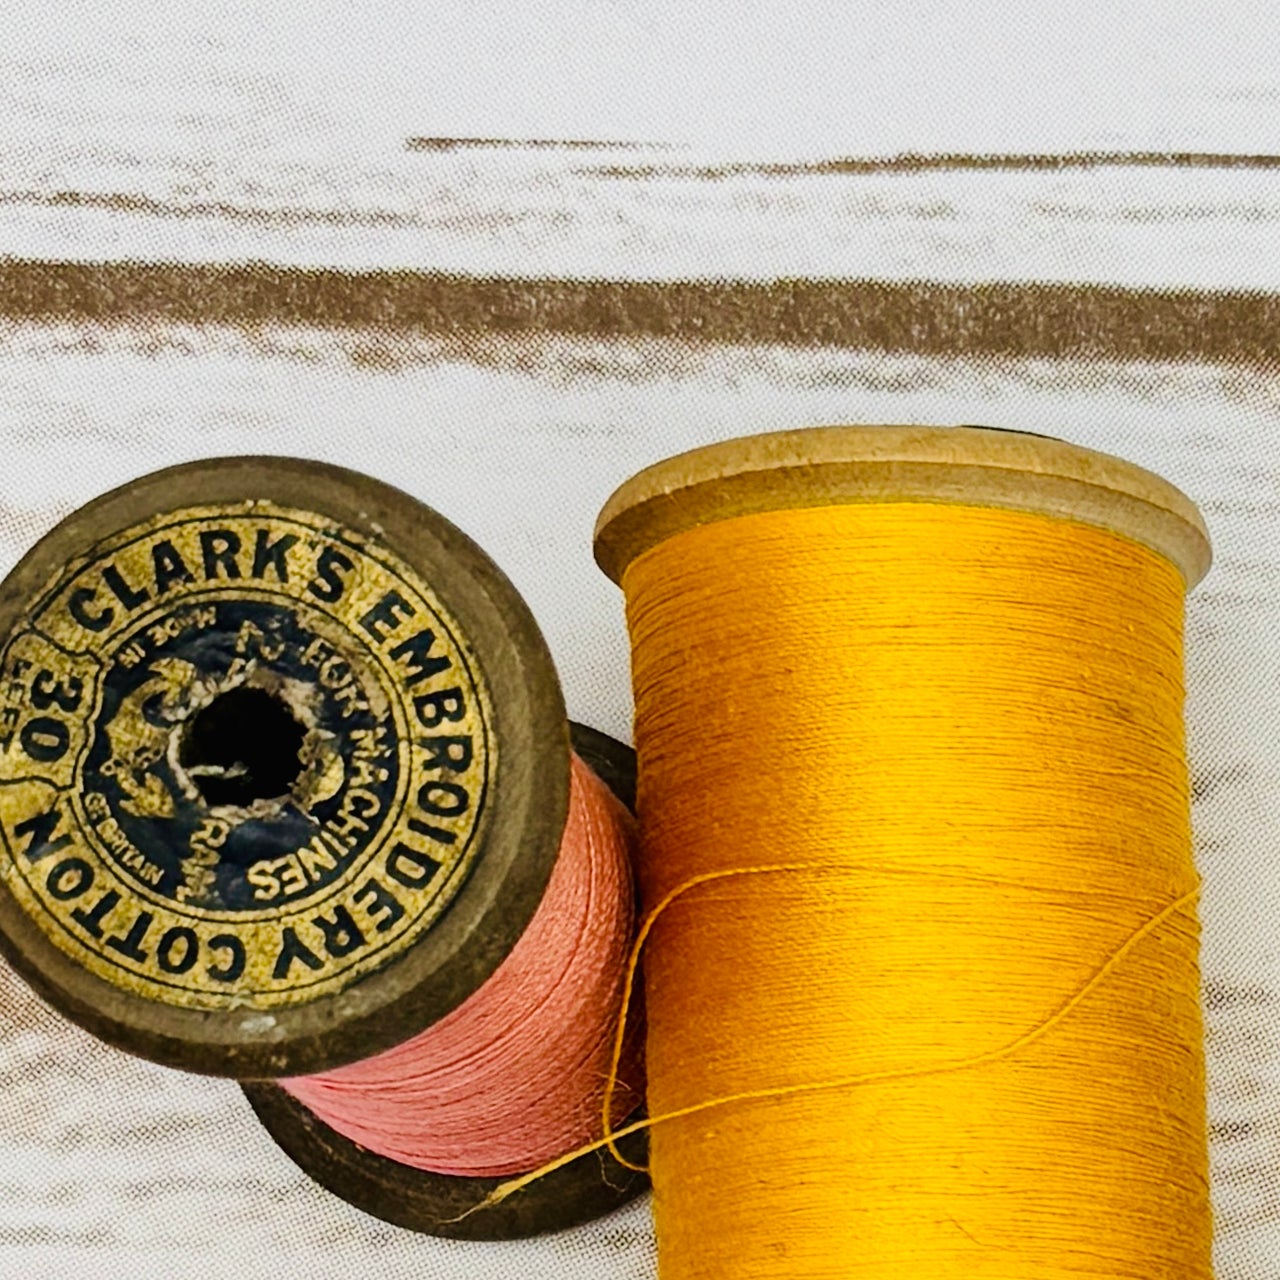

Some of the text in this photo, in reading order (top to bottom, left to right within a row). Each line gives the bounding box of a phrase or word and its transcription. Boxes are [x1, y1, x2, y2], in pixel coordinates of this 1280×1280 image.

[68, 530, 354, 631] CLARK'S
[20, 669, 83, 762] 30
[272, 589, 473, 979] EMBROIDERY
[14, 811, 246, 981] COTTON
[248, 726, 393, 900] MACHINES
